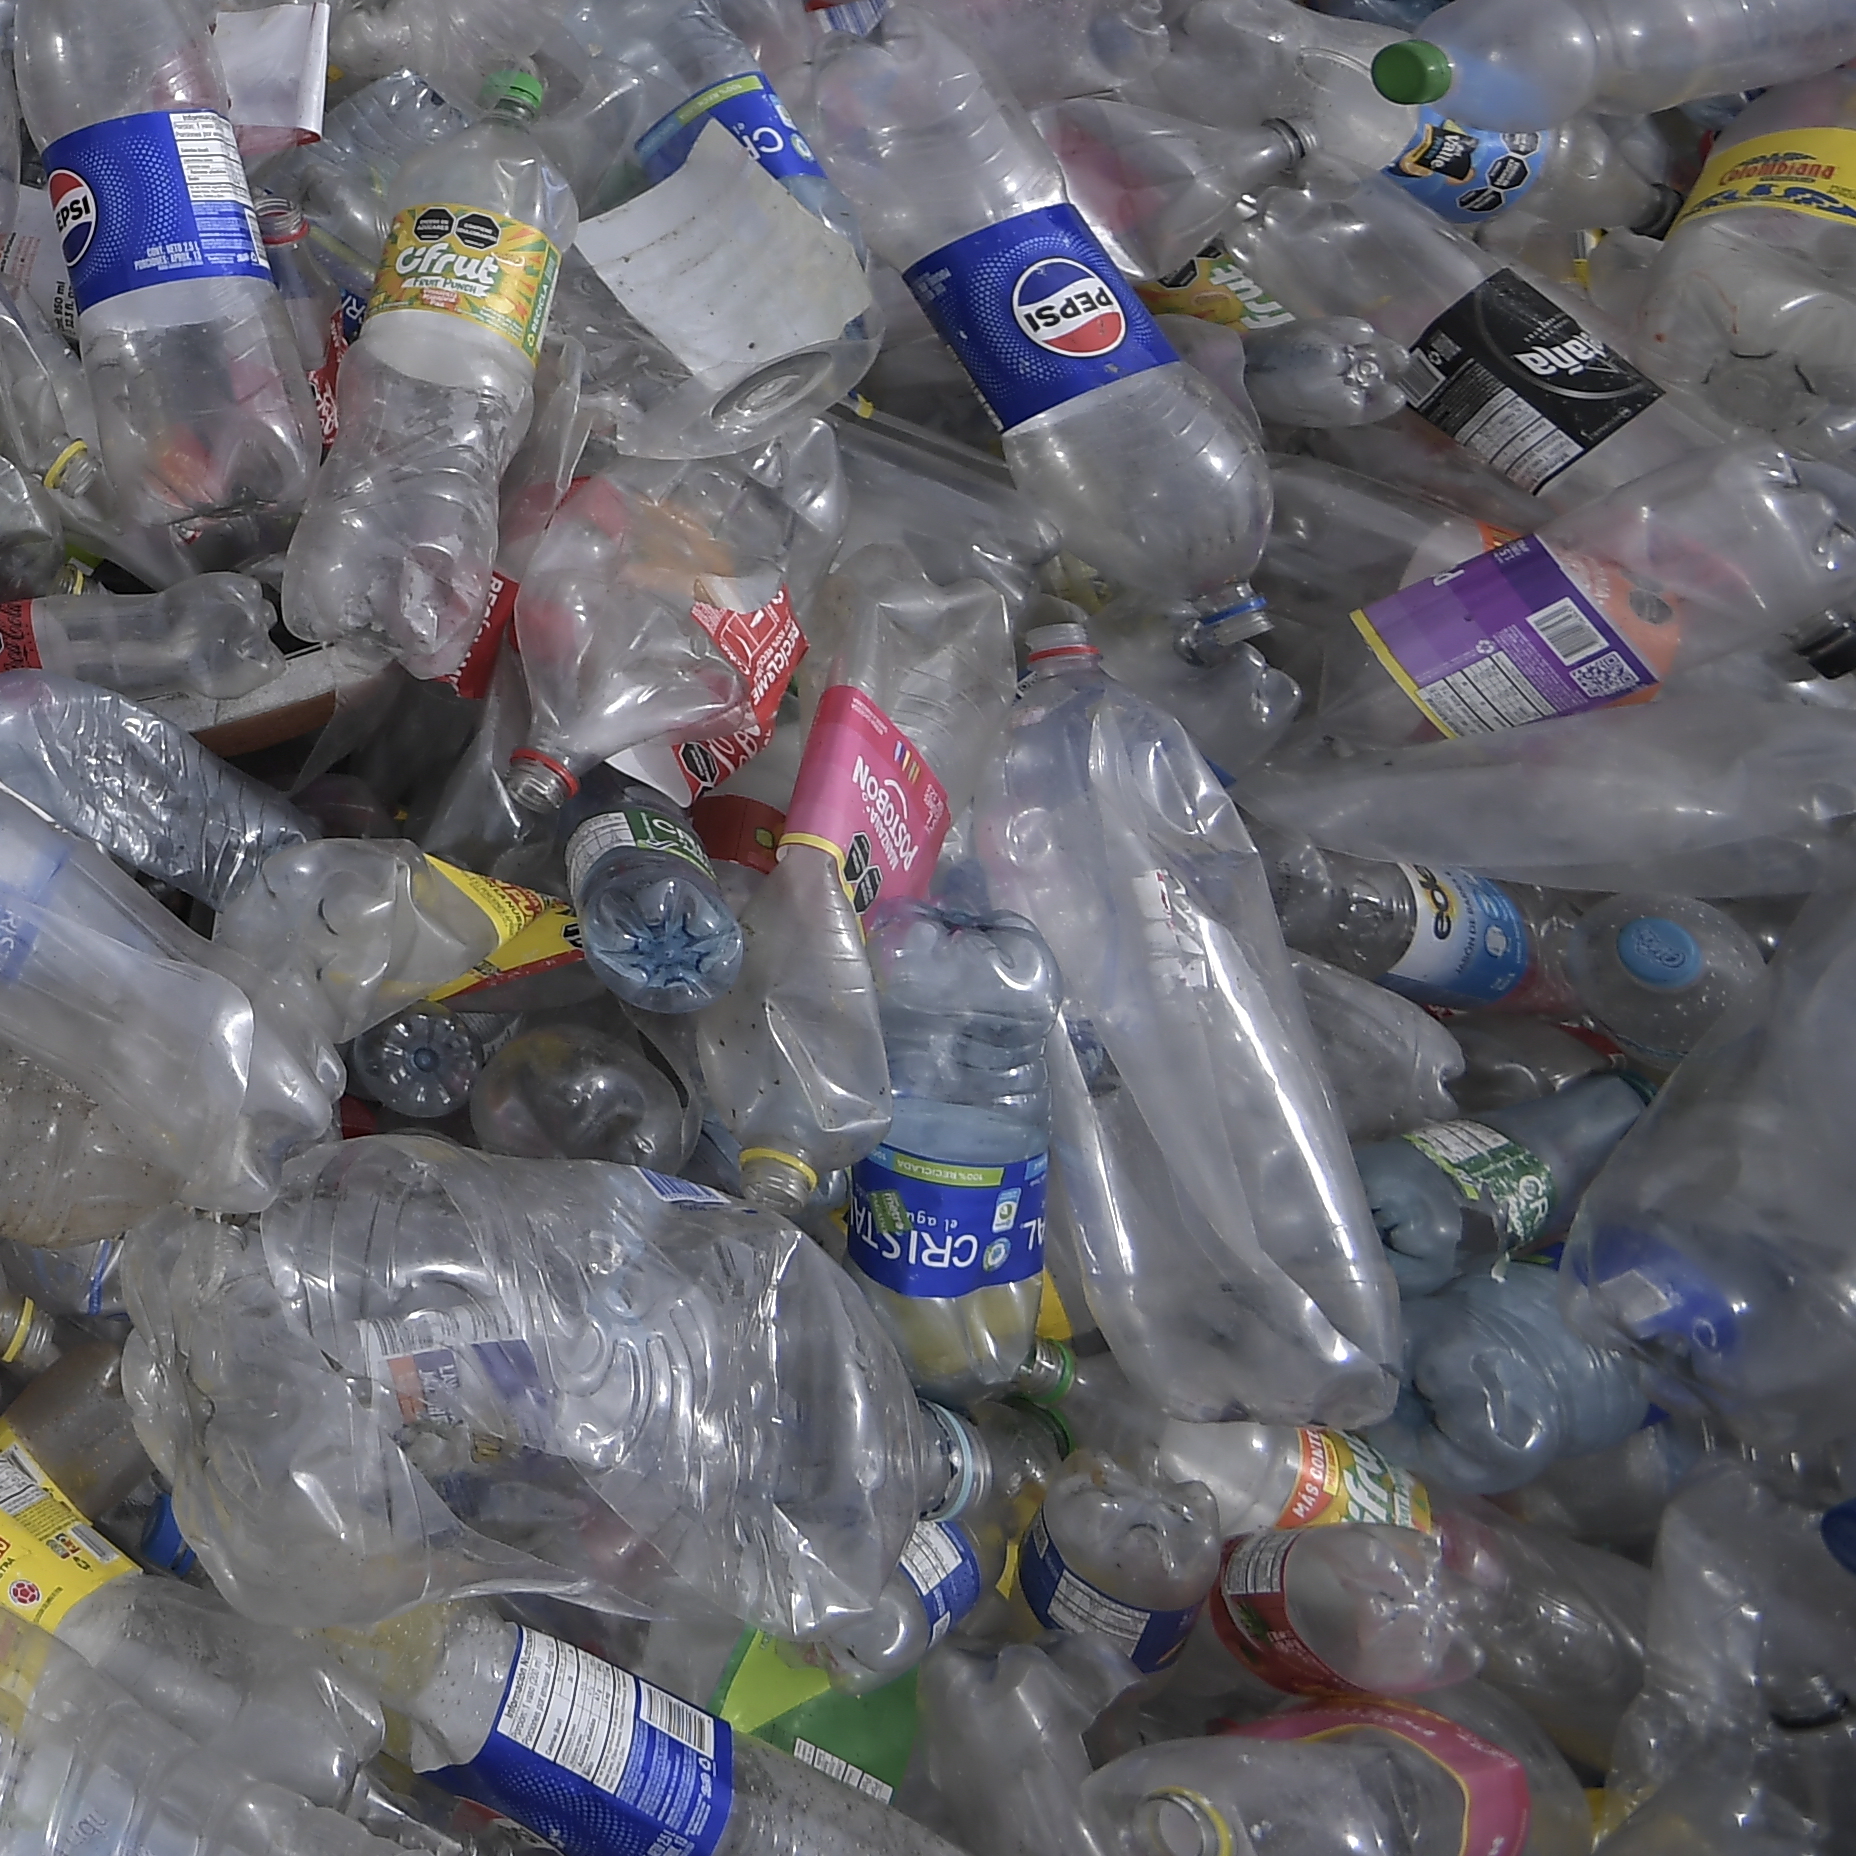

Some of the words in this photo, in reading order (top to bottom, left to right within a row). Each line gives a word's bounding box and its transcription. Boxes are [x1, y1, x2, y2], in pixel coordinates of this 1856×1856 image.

[1429, 134, 1459, 171] Valle
[1023, 285, 1114, 333] PEPSI
[1292, 1485, 1320, 1518] MÁS
